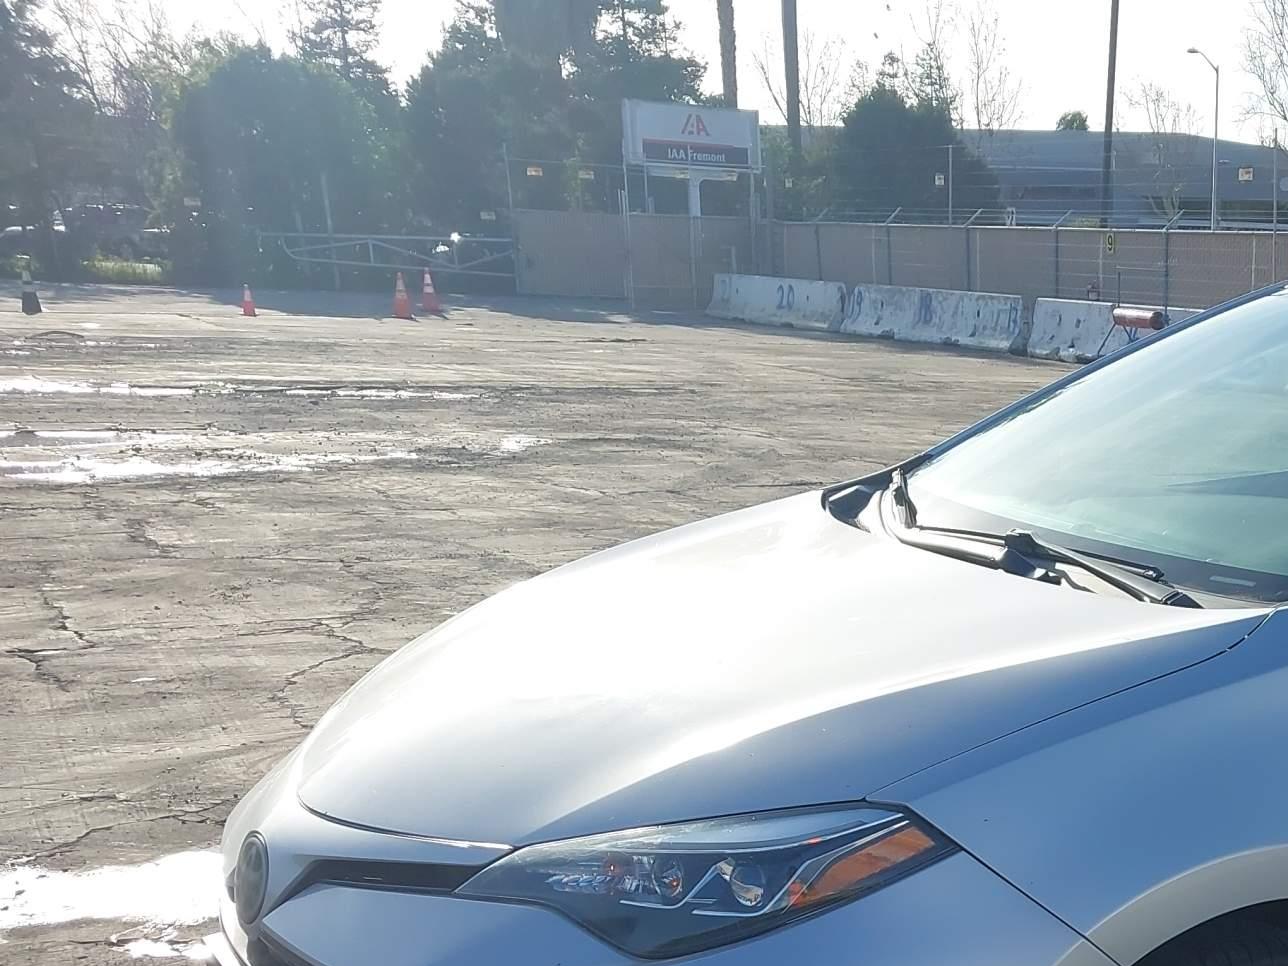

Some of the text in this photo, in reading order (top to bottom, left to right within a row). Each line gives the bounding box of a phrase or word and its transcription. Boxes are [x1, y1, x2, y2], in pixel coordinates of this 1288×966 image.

[668, 147, 726, 163] IAA Fremont
[1107, 234, 1113, 252] 9
[776, 283, 795, 310] 20
